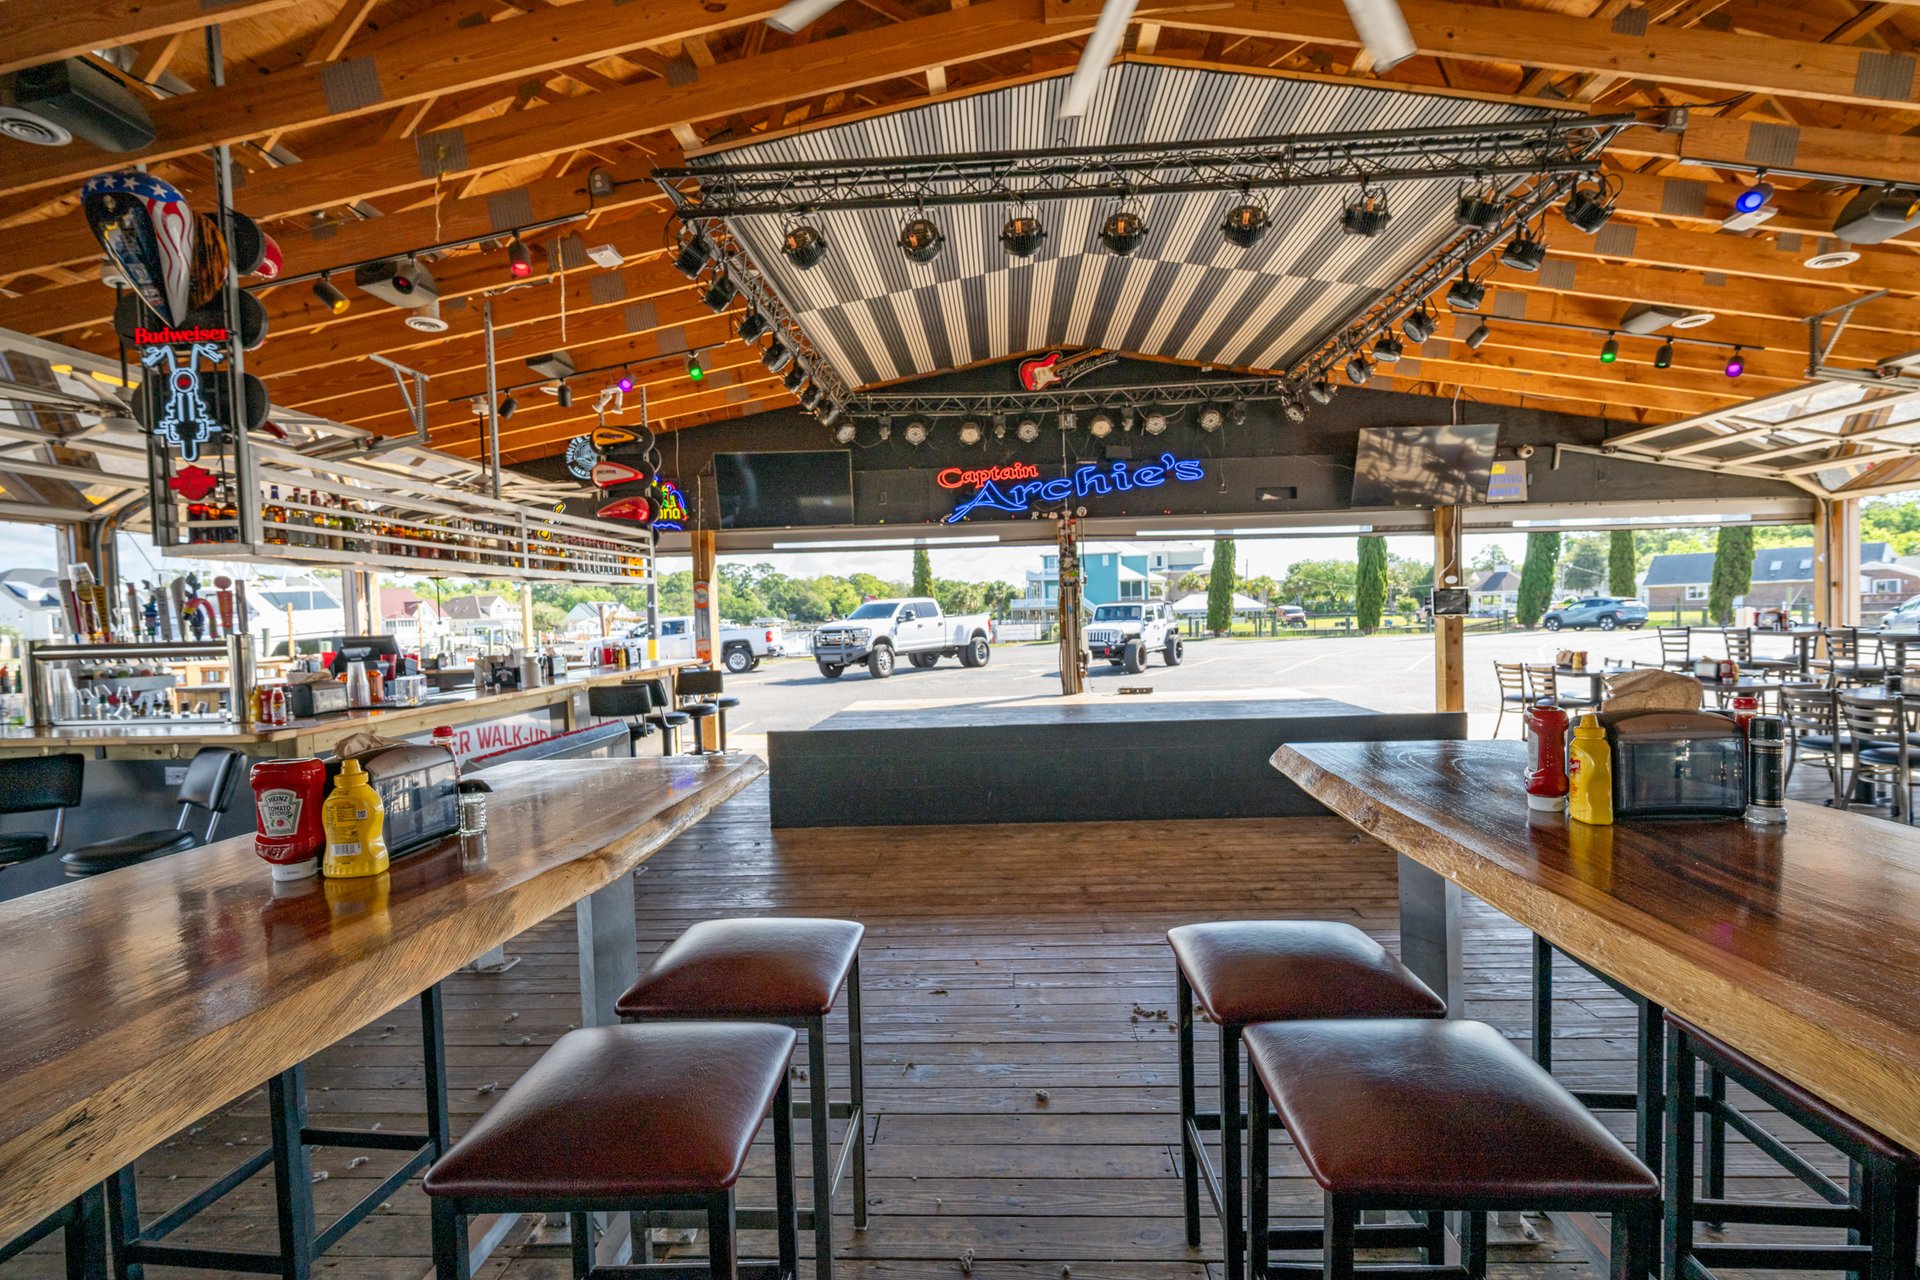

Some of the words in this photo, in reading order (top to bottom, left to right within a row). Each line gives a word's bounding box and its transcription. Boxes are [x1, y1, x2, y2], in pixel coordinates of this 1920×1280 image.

[134, 326, 228, 345] Budweiser
[937, 462, 1039, 489] Captain
[948, 452, 1204, 523] Archie's
[268, 795, 288, 803] HEINZ
